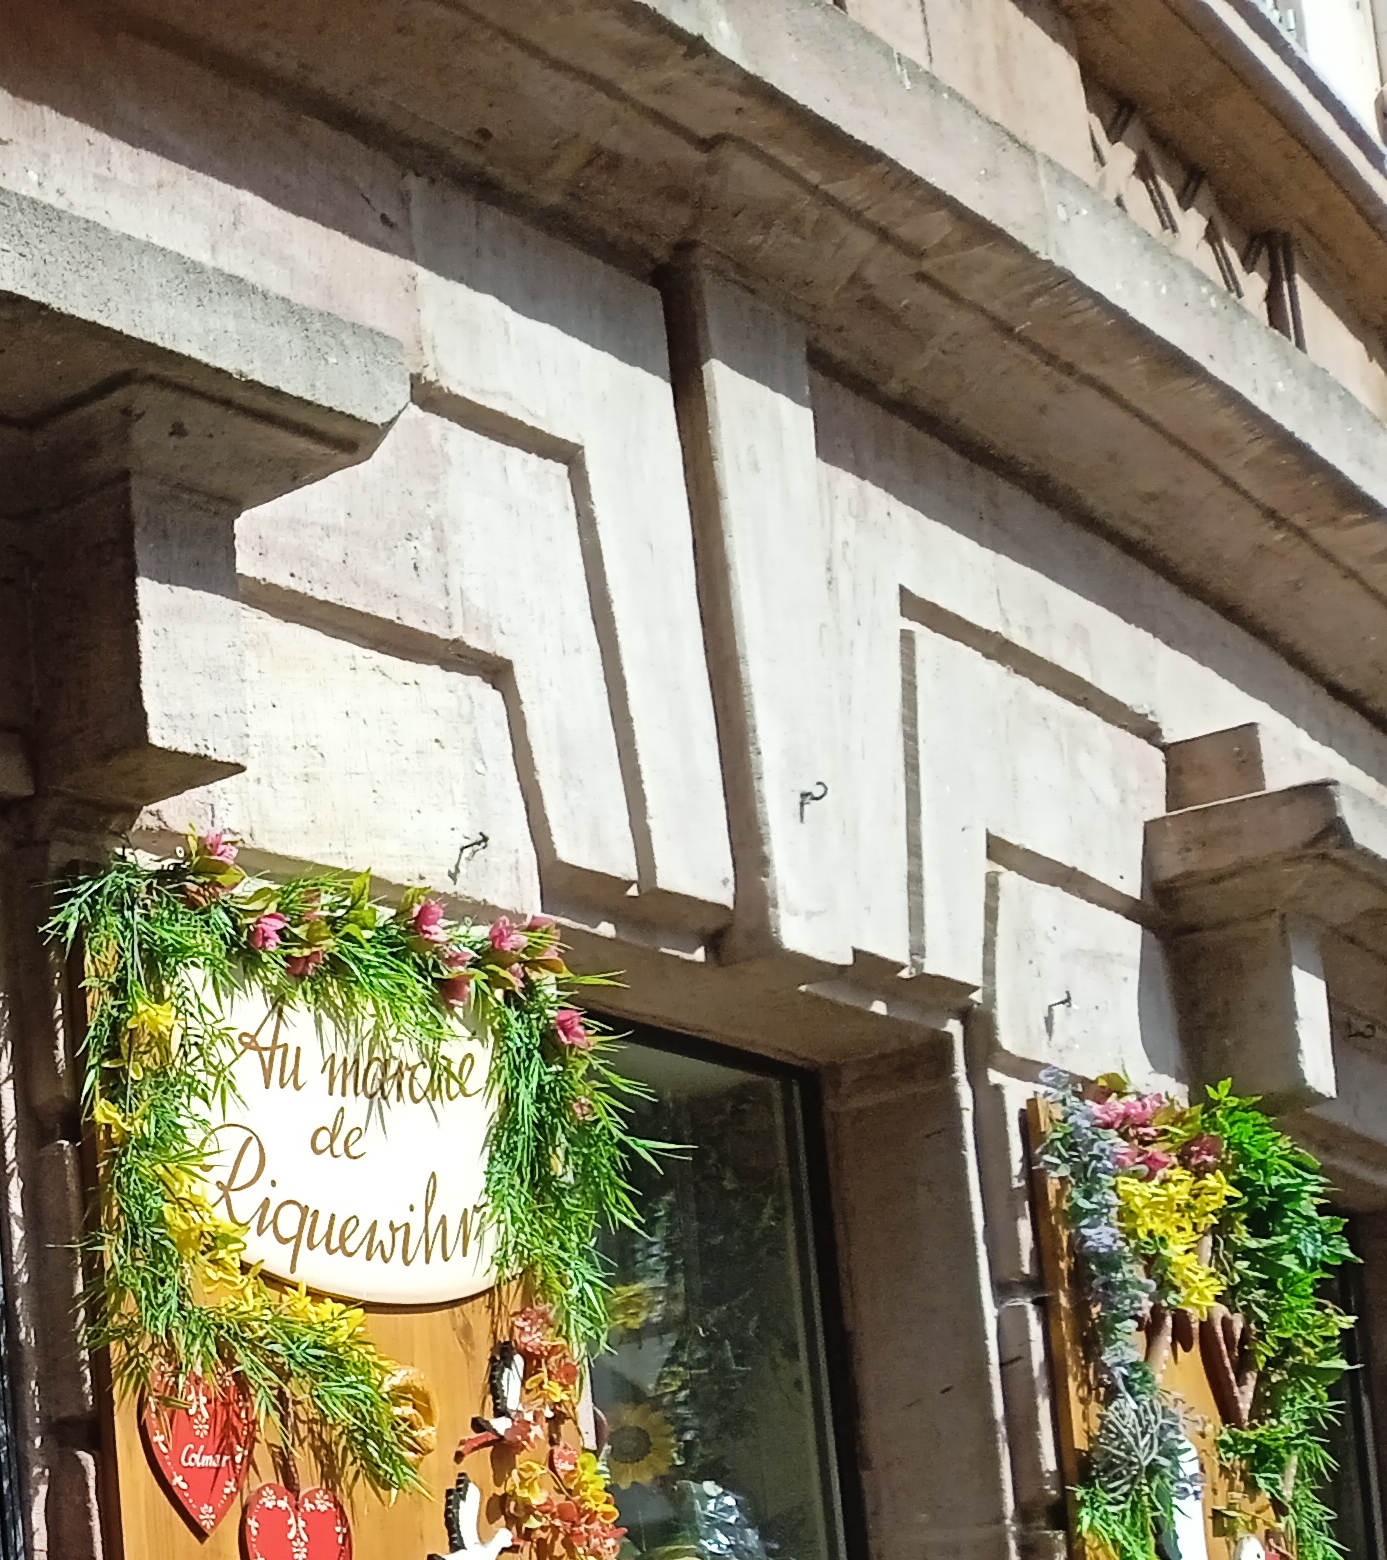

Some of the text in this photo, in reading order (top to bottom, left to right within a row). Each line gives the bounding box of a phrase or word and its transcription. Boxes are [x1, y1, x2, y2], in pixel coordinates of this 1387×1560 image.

[228, 998, 308, 1092] Au
[310, 1106, 367, 1160] de
[199, 1123, 487, 1275] Riquewihr
[181, 1443, 232, 1468] Colmar
